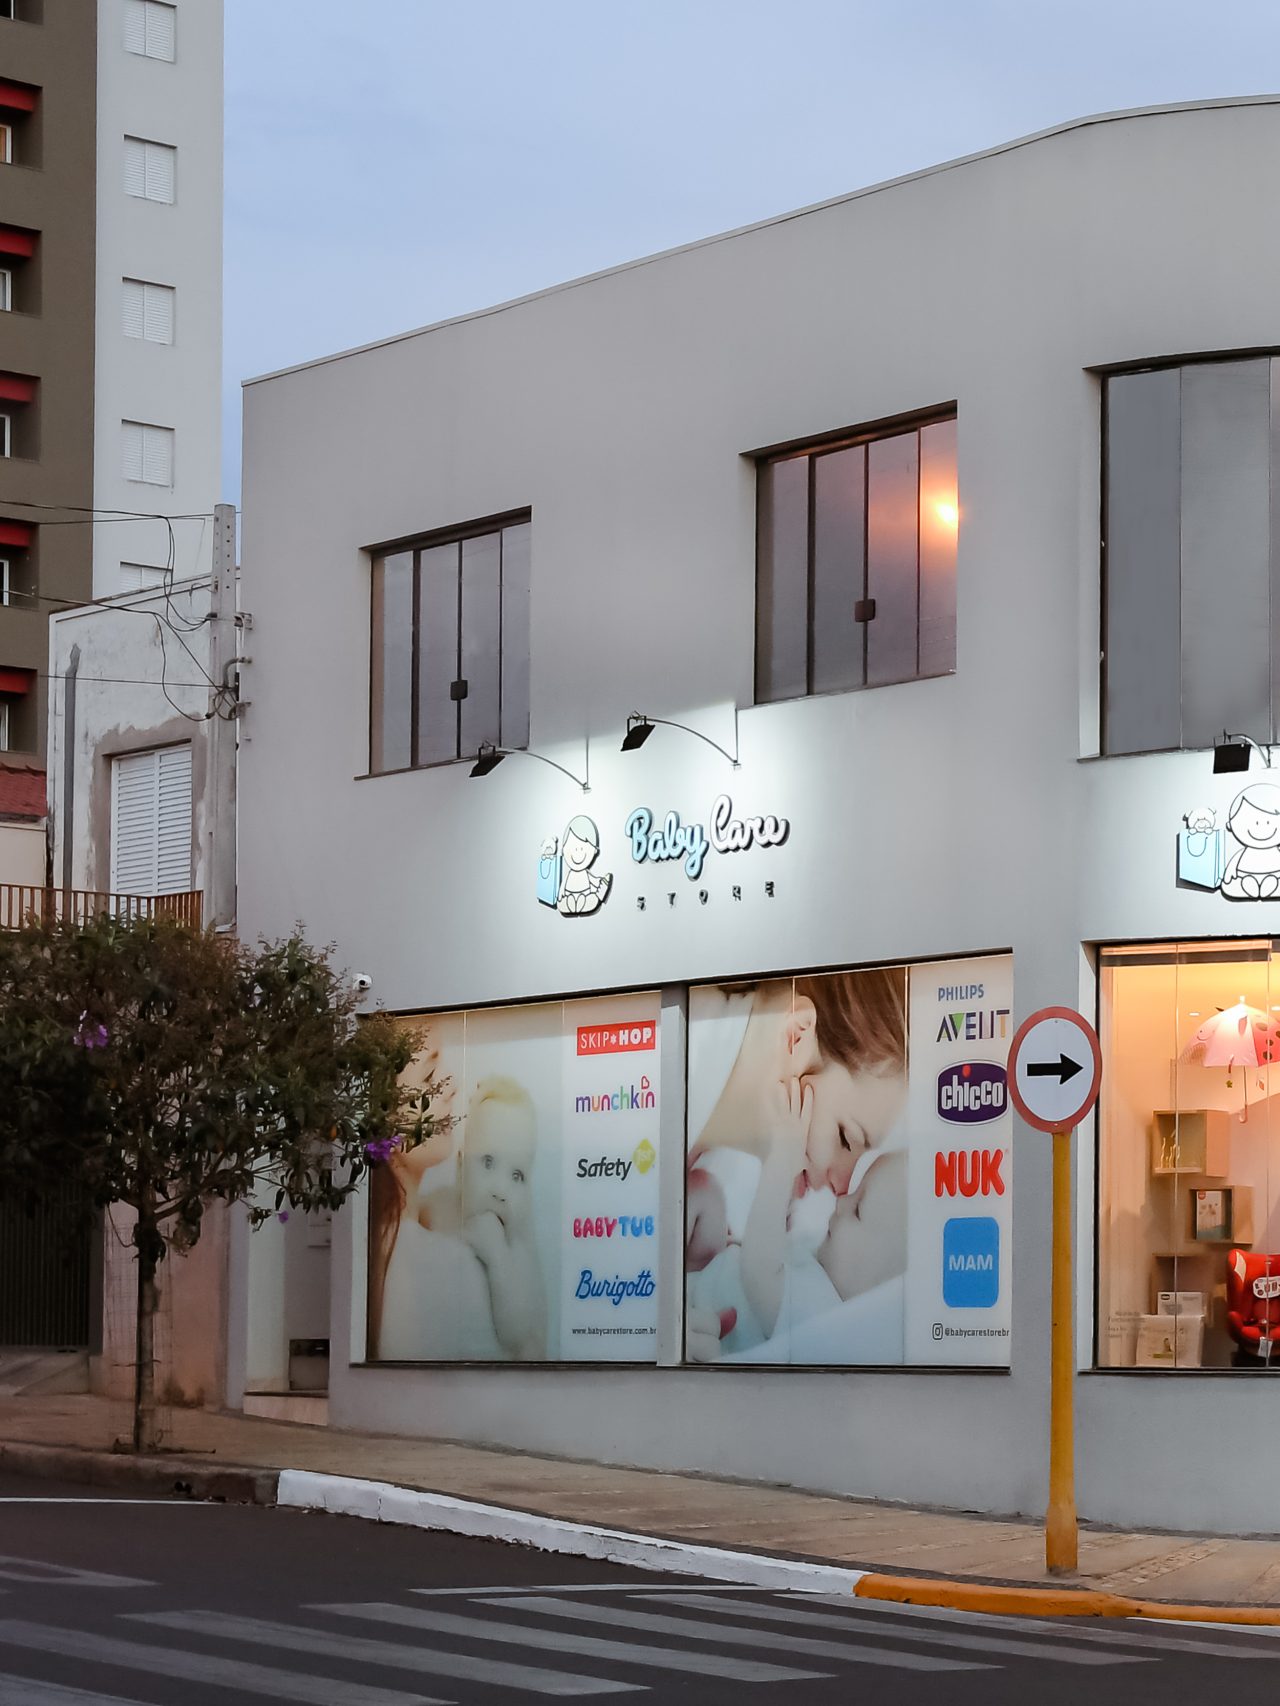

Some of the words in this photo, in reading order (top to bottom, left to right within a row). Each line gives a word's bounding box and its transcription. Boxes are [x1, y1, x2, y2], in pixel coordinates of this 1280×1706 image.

[625, 807, 709, 880] Baby
[710, 794, 790, 854] Care
[636, 881, 775, 911] STORE
[937, 983, 985, 1002] PHILIPS
[580, 1030, 610, 1049] SKIP
[618, 1026, 653, 1046] HOP
[575, 1077, 655, 1113] munchkin
[941, 1064, 1004, 1111] chicco
[576, 1156, 632, 1181] Safety
[934, 1148, 1006, 1198] NUK
[949, 1253, 994, 1272] MAM
[575, 1268, 656, 1306] Burigotto
